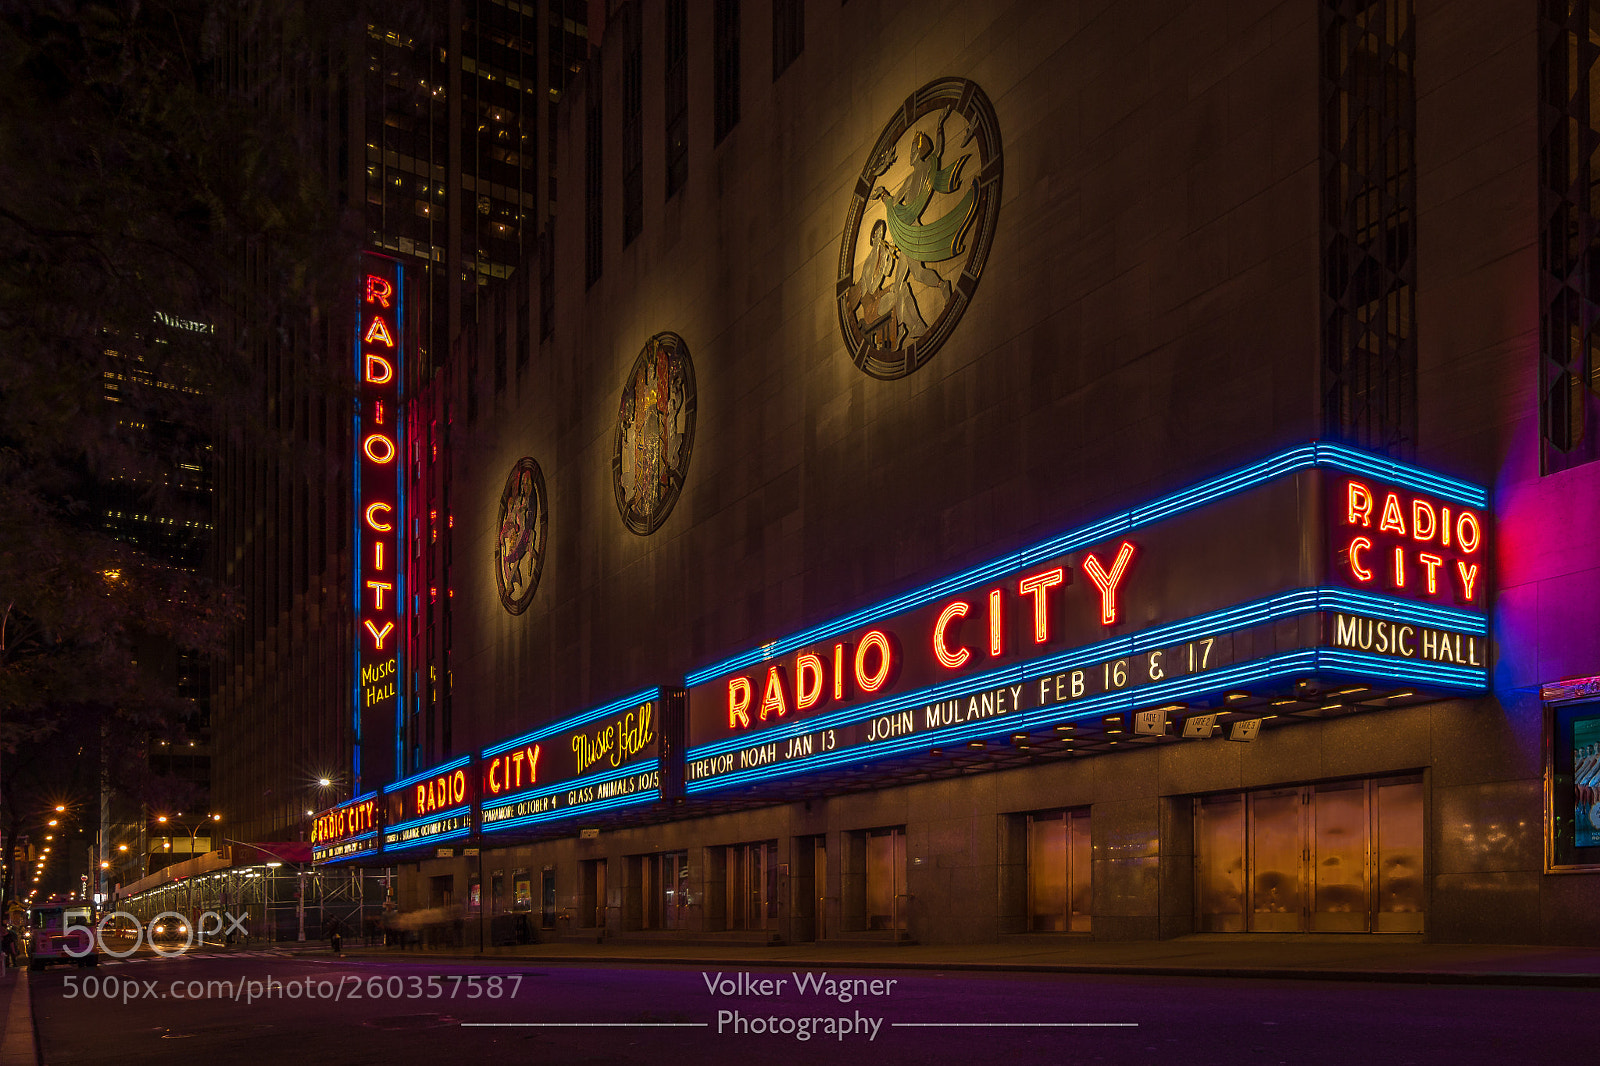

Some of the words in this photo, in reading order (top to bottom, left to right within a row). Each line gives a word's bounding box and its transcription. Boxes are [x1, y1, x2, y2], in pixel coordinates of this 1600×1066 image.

[364, 274, 395, 464] RADIO
[1348, 475, 1482, 554] RADIO
[364, 501, 395, 650] CITY
[1349, 536, 1478, 601] CITY
[727, 628, 891, 730] RADIO
[933, 540, 1135, 669] CITY
[1337, 614, 1414, 657] MUSIC
[1423, 629, 1481, 666] HALL
[362, 659, 395, 687] MUSIC
[367, 682, 395, 707] HALL
[572, 726, 614, 775] Music
[611, 702, 653, 767] Hall
[691, 753, 734, 780] TREVOR
[740, 743, 776, 770] NOAH
[785, 734, 812, 760] JAN
[821, 729, 836, 751] 13
[867, 711, 913, 742] JOHN
[926, 685, 1023, 729] MULANEY
[1040, 670, 1085, 705] FEB
[1104, 660, 1127, 690] 16
[1149, 651, 1164, 681] &
[1189, 637, 1215, 673] 17
[416, 769, 466, 816] RADIO
[488, 743, 540, 793] CITY
[517, 796, 548, 817] OCTOBER
[551, 794, 556, 809] 4
[568, 786, 593, 806] GLASS
[597, 776, 635, 799] ANIMALS
[638, 771, 659, 791] 10/5
[318, 811, 344, 842] RADIO
[348, 801, 374, 829] CITY
